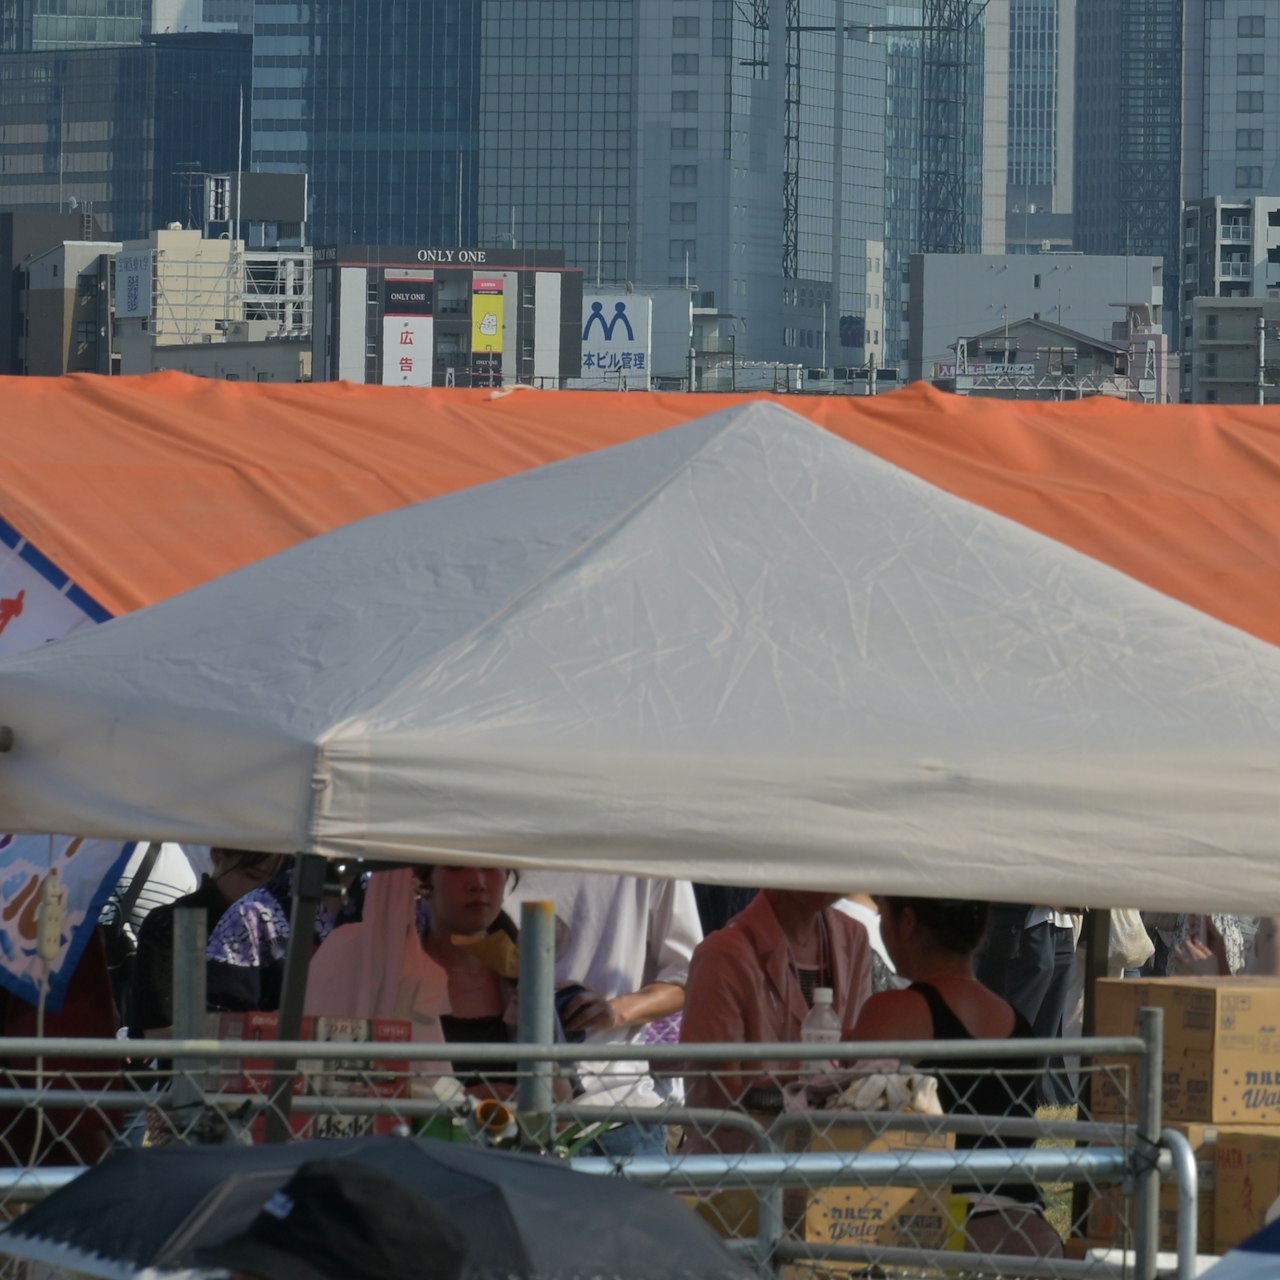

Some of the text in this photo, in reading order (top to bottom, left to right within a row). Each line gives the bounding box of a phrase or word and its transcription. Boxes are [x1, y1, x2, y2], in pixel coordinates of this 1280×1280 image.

[417, 249, 487, 263] ONLY ONE
[391, 293, 426, 301] ONLY ONE
[399, 331, 415, 386] 広告
[583, 352, 645, 370] 本ビル管理
[828, 1222, 885, 1240] Water
